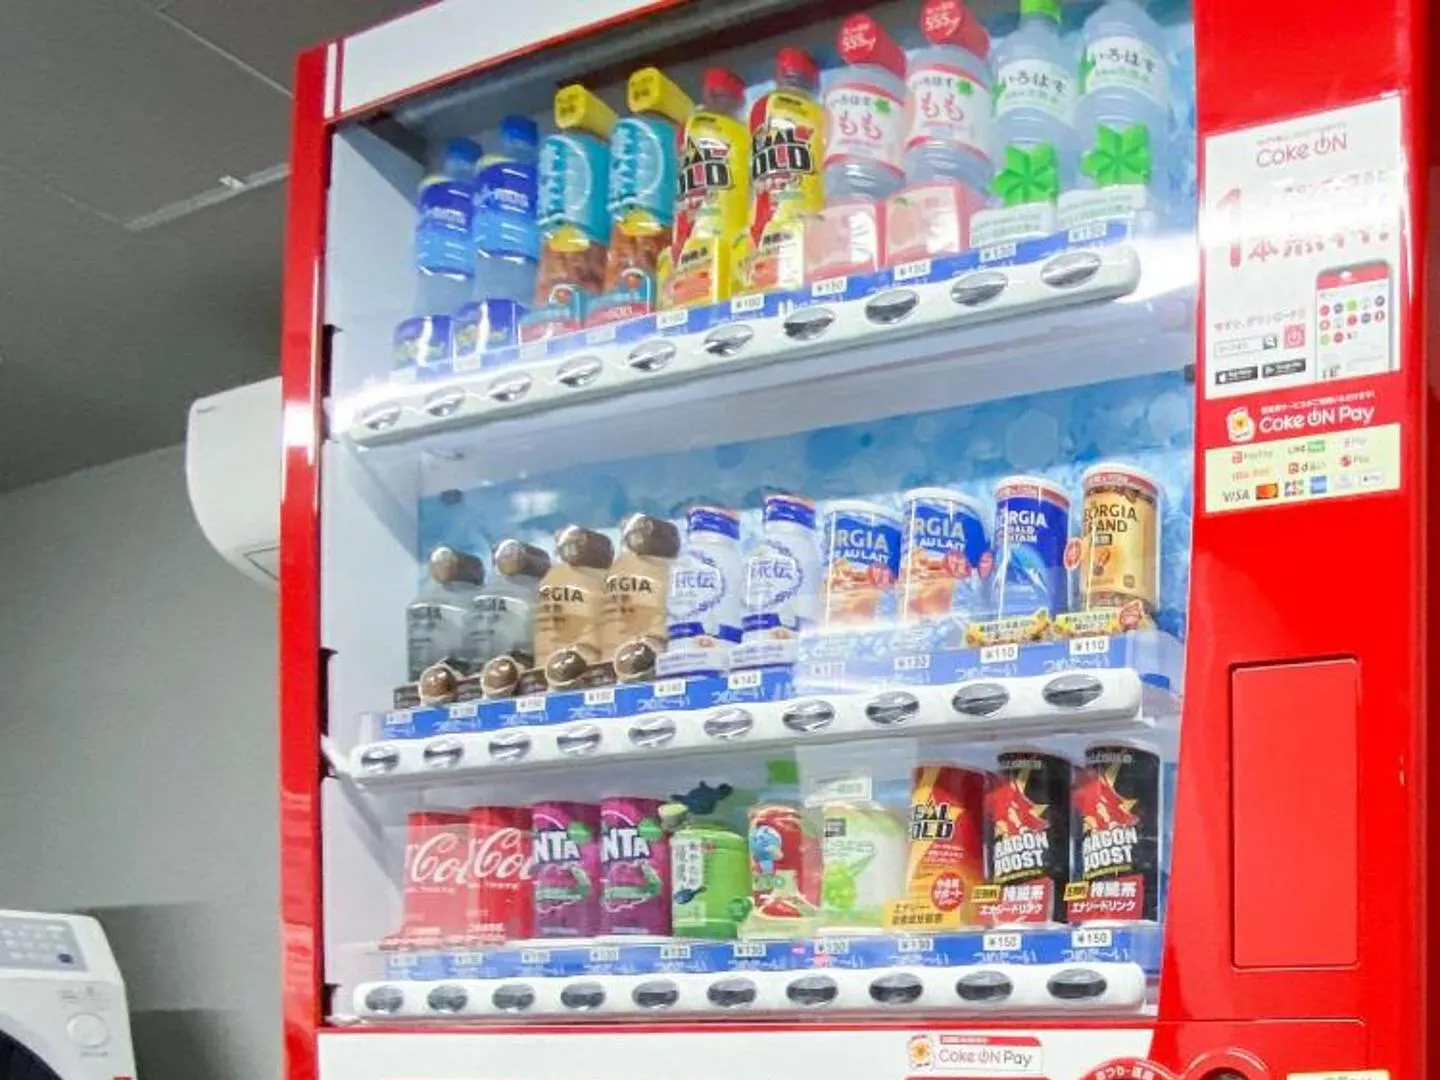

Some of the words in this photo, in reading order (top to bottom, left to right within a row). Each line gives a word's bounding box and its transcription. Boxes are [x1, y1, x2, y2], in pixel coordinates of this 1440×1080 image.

[1256, 143, 1309, 168] Coke
[1314, 131, 1348, 155] ON
[1259, 414, 1305, 433] Coke
[1307, 406, 1336, 427] ON
[1338, 404, 1376, 425] Pay
[1222, 489, 1250, 503] VISA
[989, 935, 1017, 948] ¥150
[1077, 932, 1107, 945] ¥150
[939, 1049, 975, 1064] Coke
[978, 1048, 1001, 1064] ON
[1003, 1050, 1033, 1068] Pay
